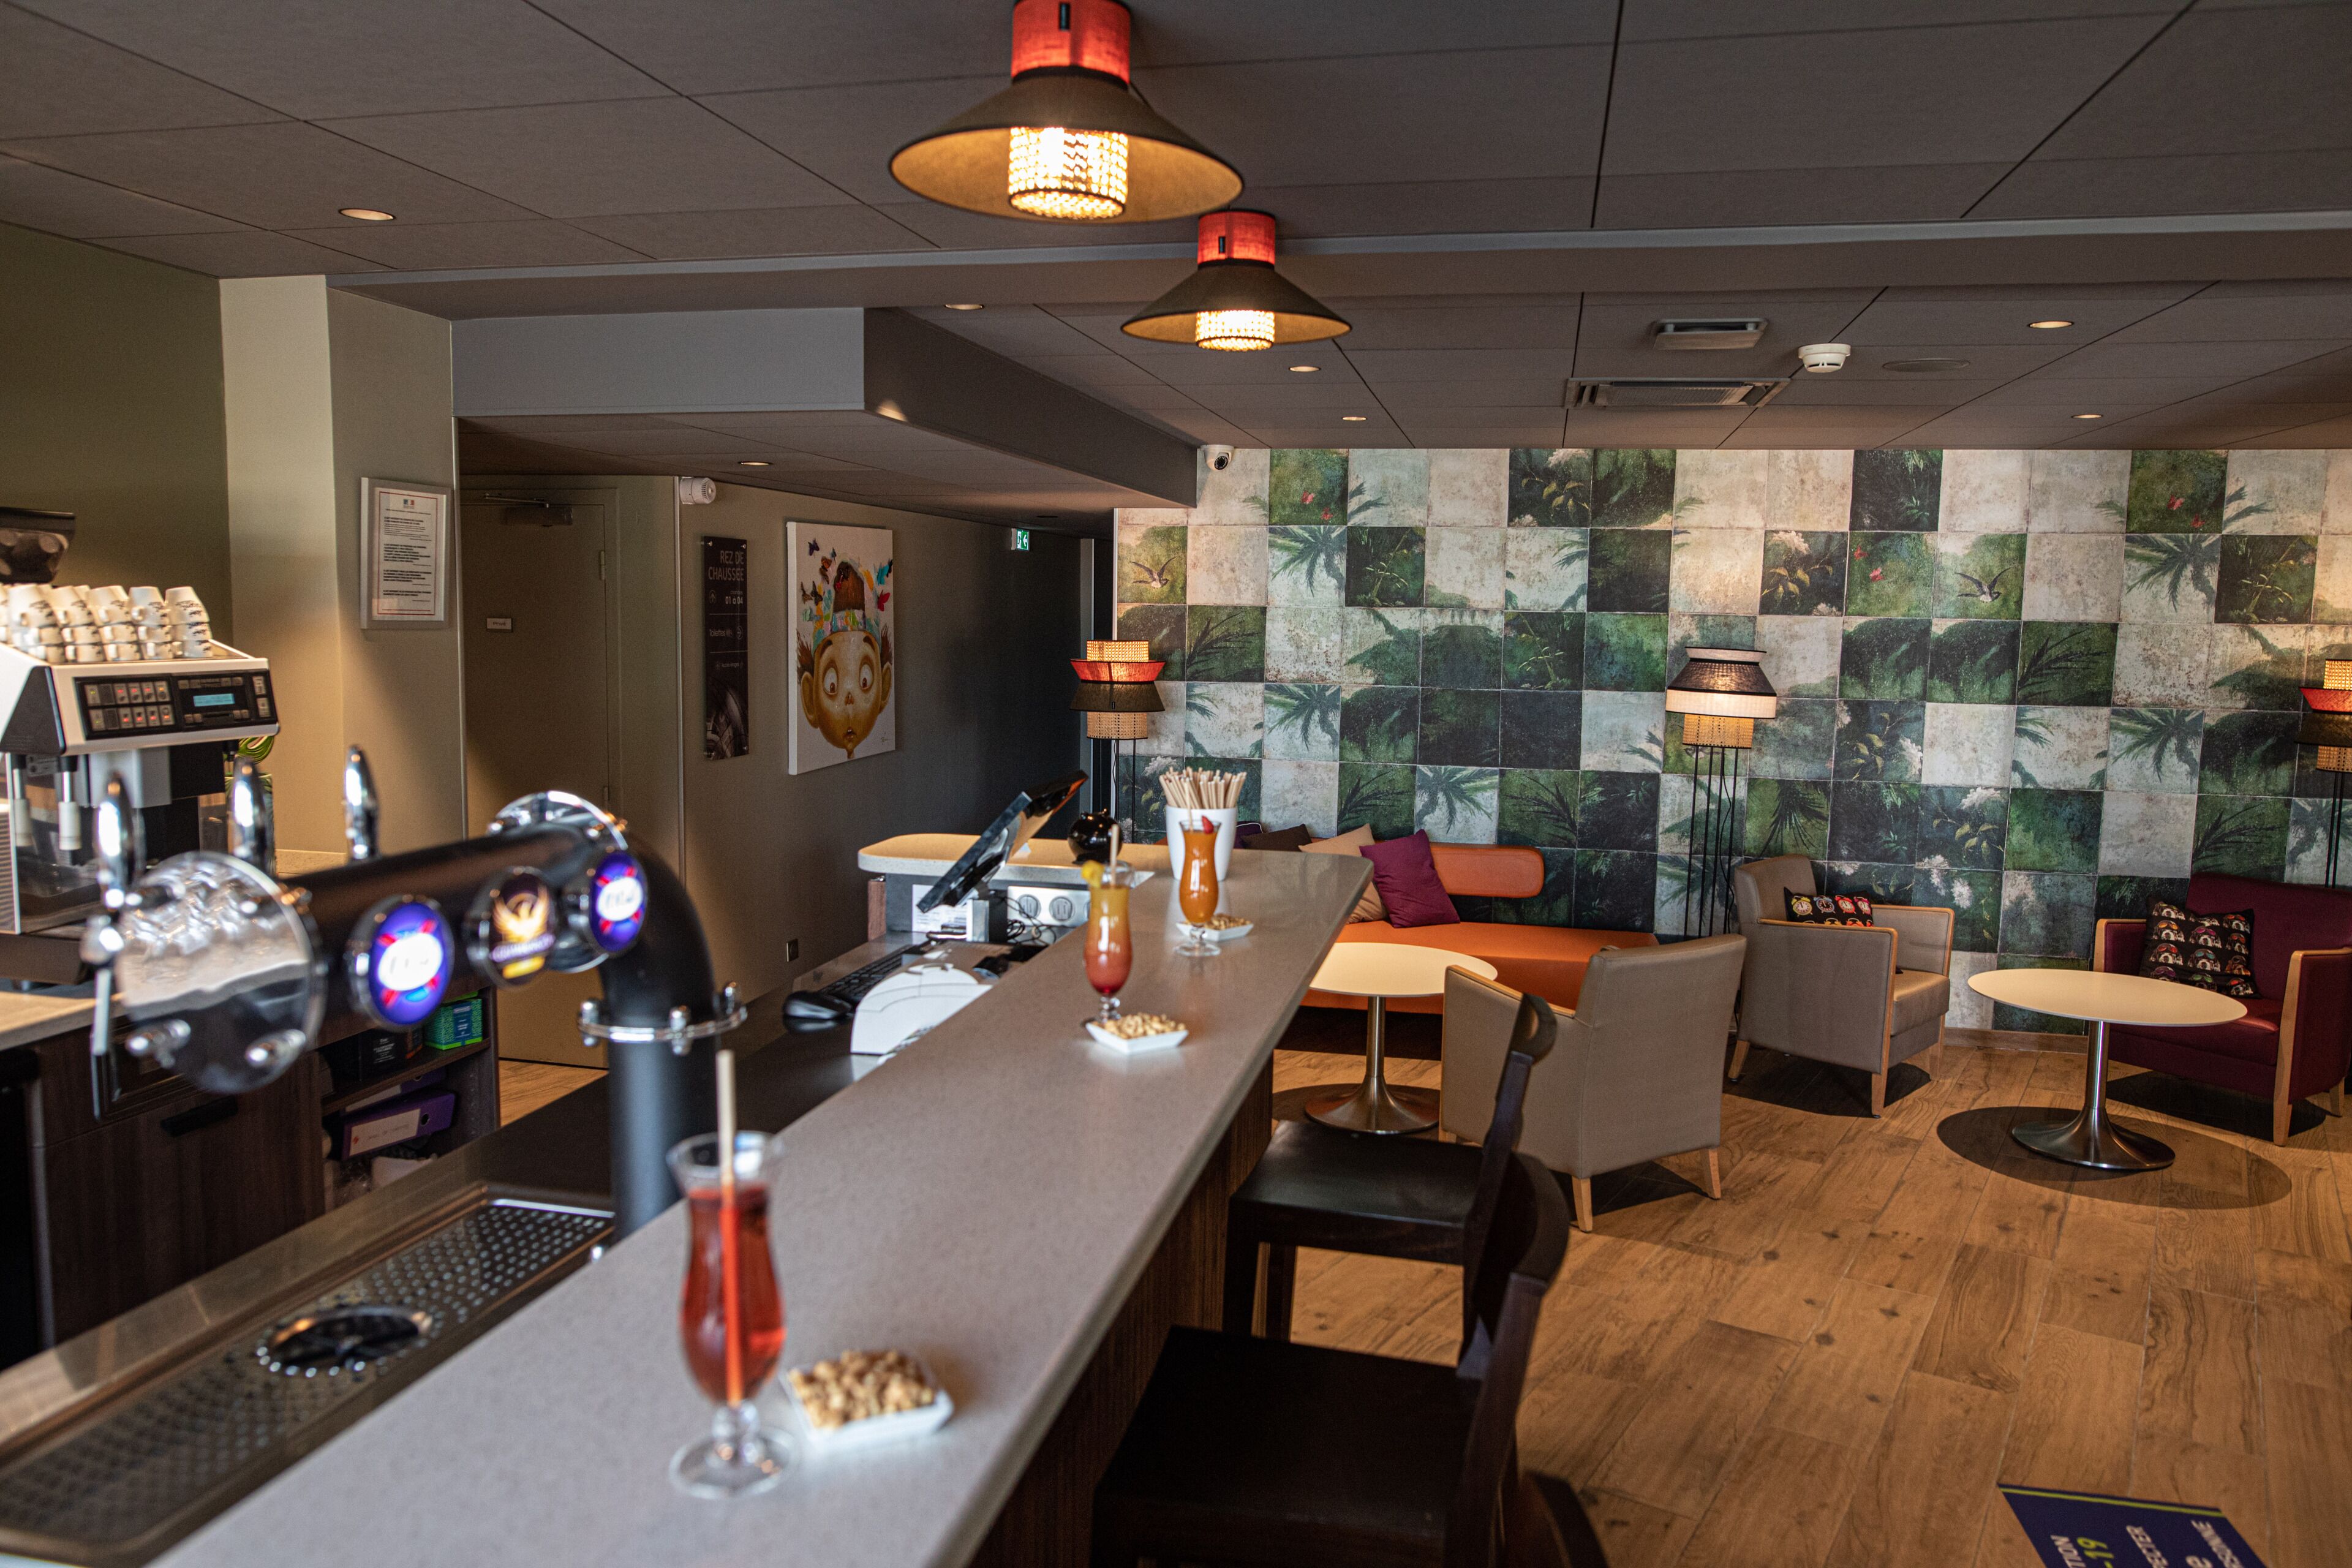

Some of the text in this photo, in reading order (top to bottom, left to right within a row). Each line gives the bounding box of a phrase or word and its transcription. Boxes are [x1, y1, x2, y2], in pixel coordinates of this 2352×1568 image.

[720, 550, 744, 565] REZ DE
[708, 567, 745, 581] CHAUSSEE
[725, 596, 731, 605] 01
[737, 596, 744, 605] 04
